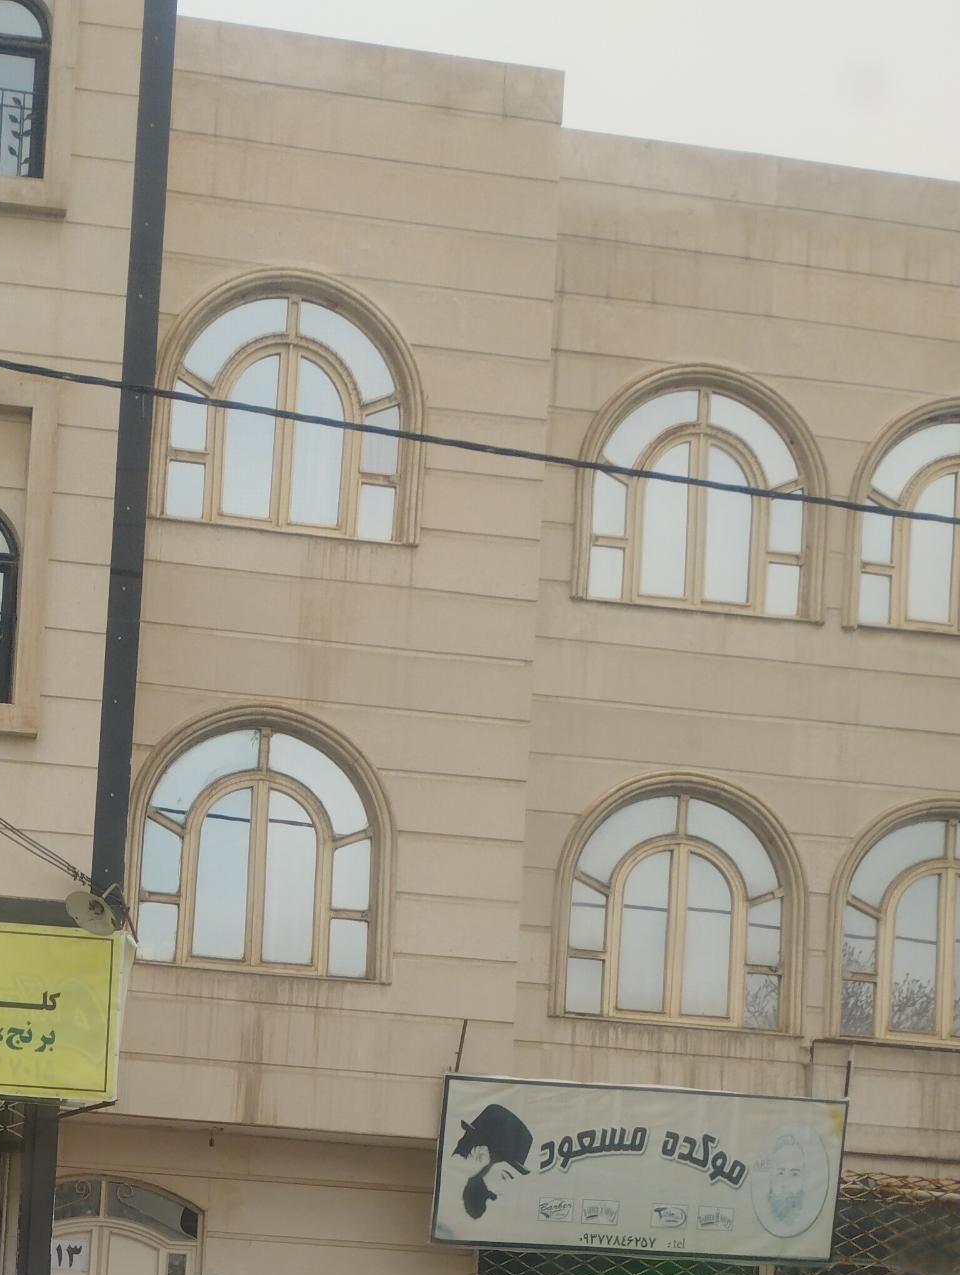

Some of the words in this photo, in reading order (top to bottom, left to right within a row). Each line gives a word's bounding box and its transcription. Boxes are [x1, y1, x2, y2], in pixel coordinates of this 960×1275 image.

[540, 1126, 648, 1172] مسعود
[661, 1129, 748, 1187] موکده
[55, 1243, 83, 1269] ۱۳
